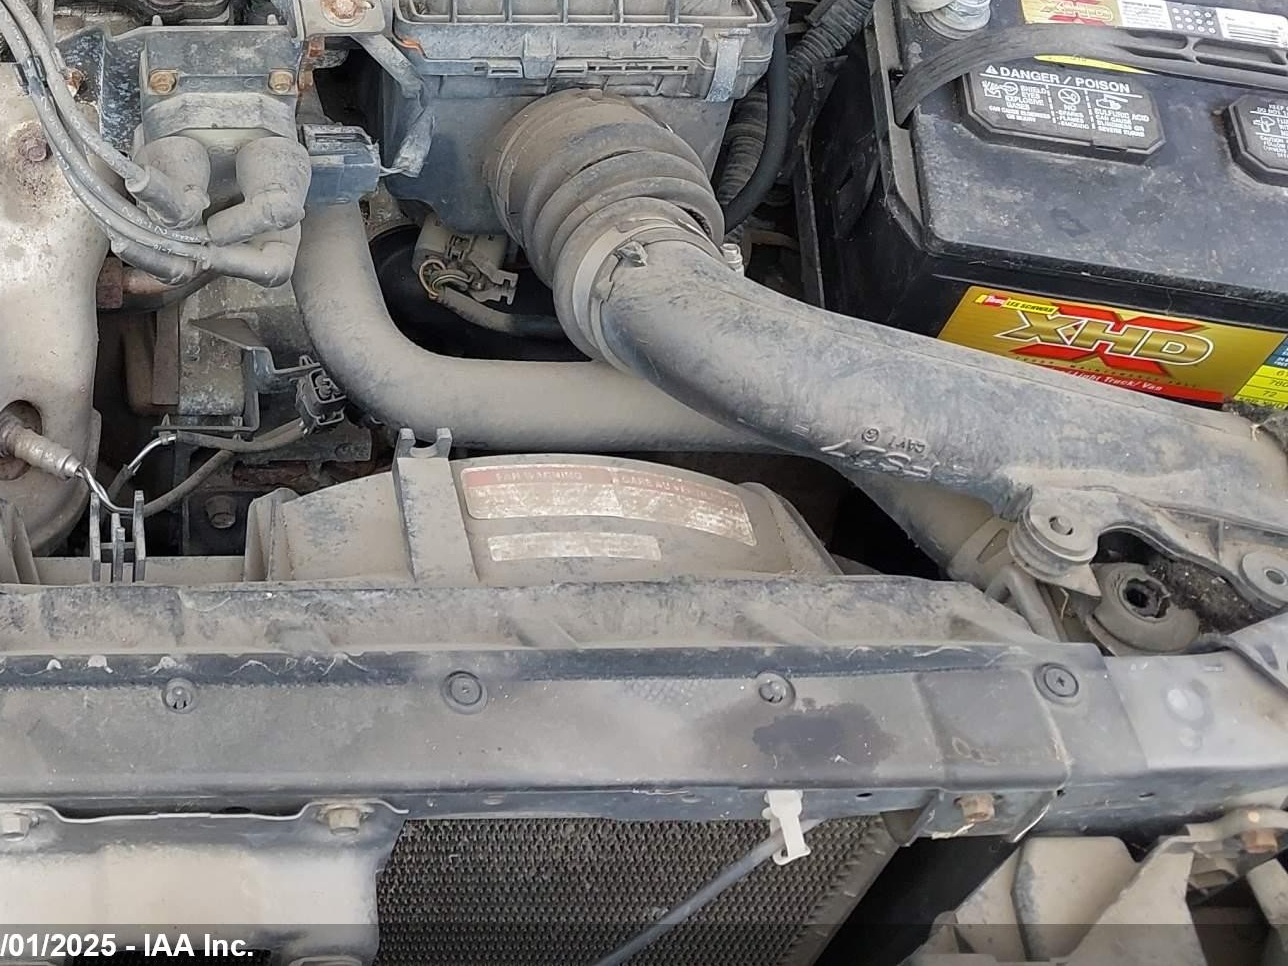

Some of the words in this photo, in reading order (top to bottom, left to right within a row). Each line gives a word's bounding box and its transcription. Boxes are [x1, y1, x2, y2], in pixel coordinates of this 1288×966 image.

[999, 67, 1060, 85] DANGER
[1075, 77, 1131, 94] POISON
[1020, 85, 1047, 95] SHIELD
[1022, 92, 1041, 100] EYES
[1004, 95, 1045, 107] EXPLOSIVE
[1094, 107, 1130, 119] SULFURIC
[1132, 114, 1150, 122] ACID
[996, 310, 1214, 366] XHD
[1142, 381, 1164, 392] Van
